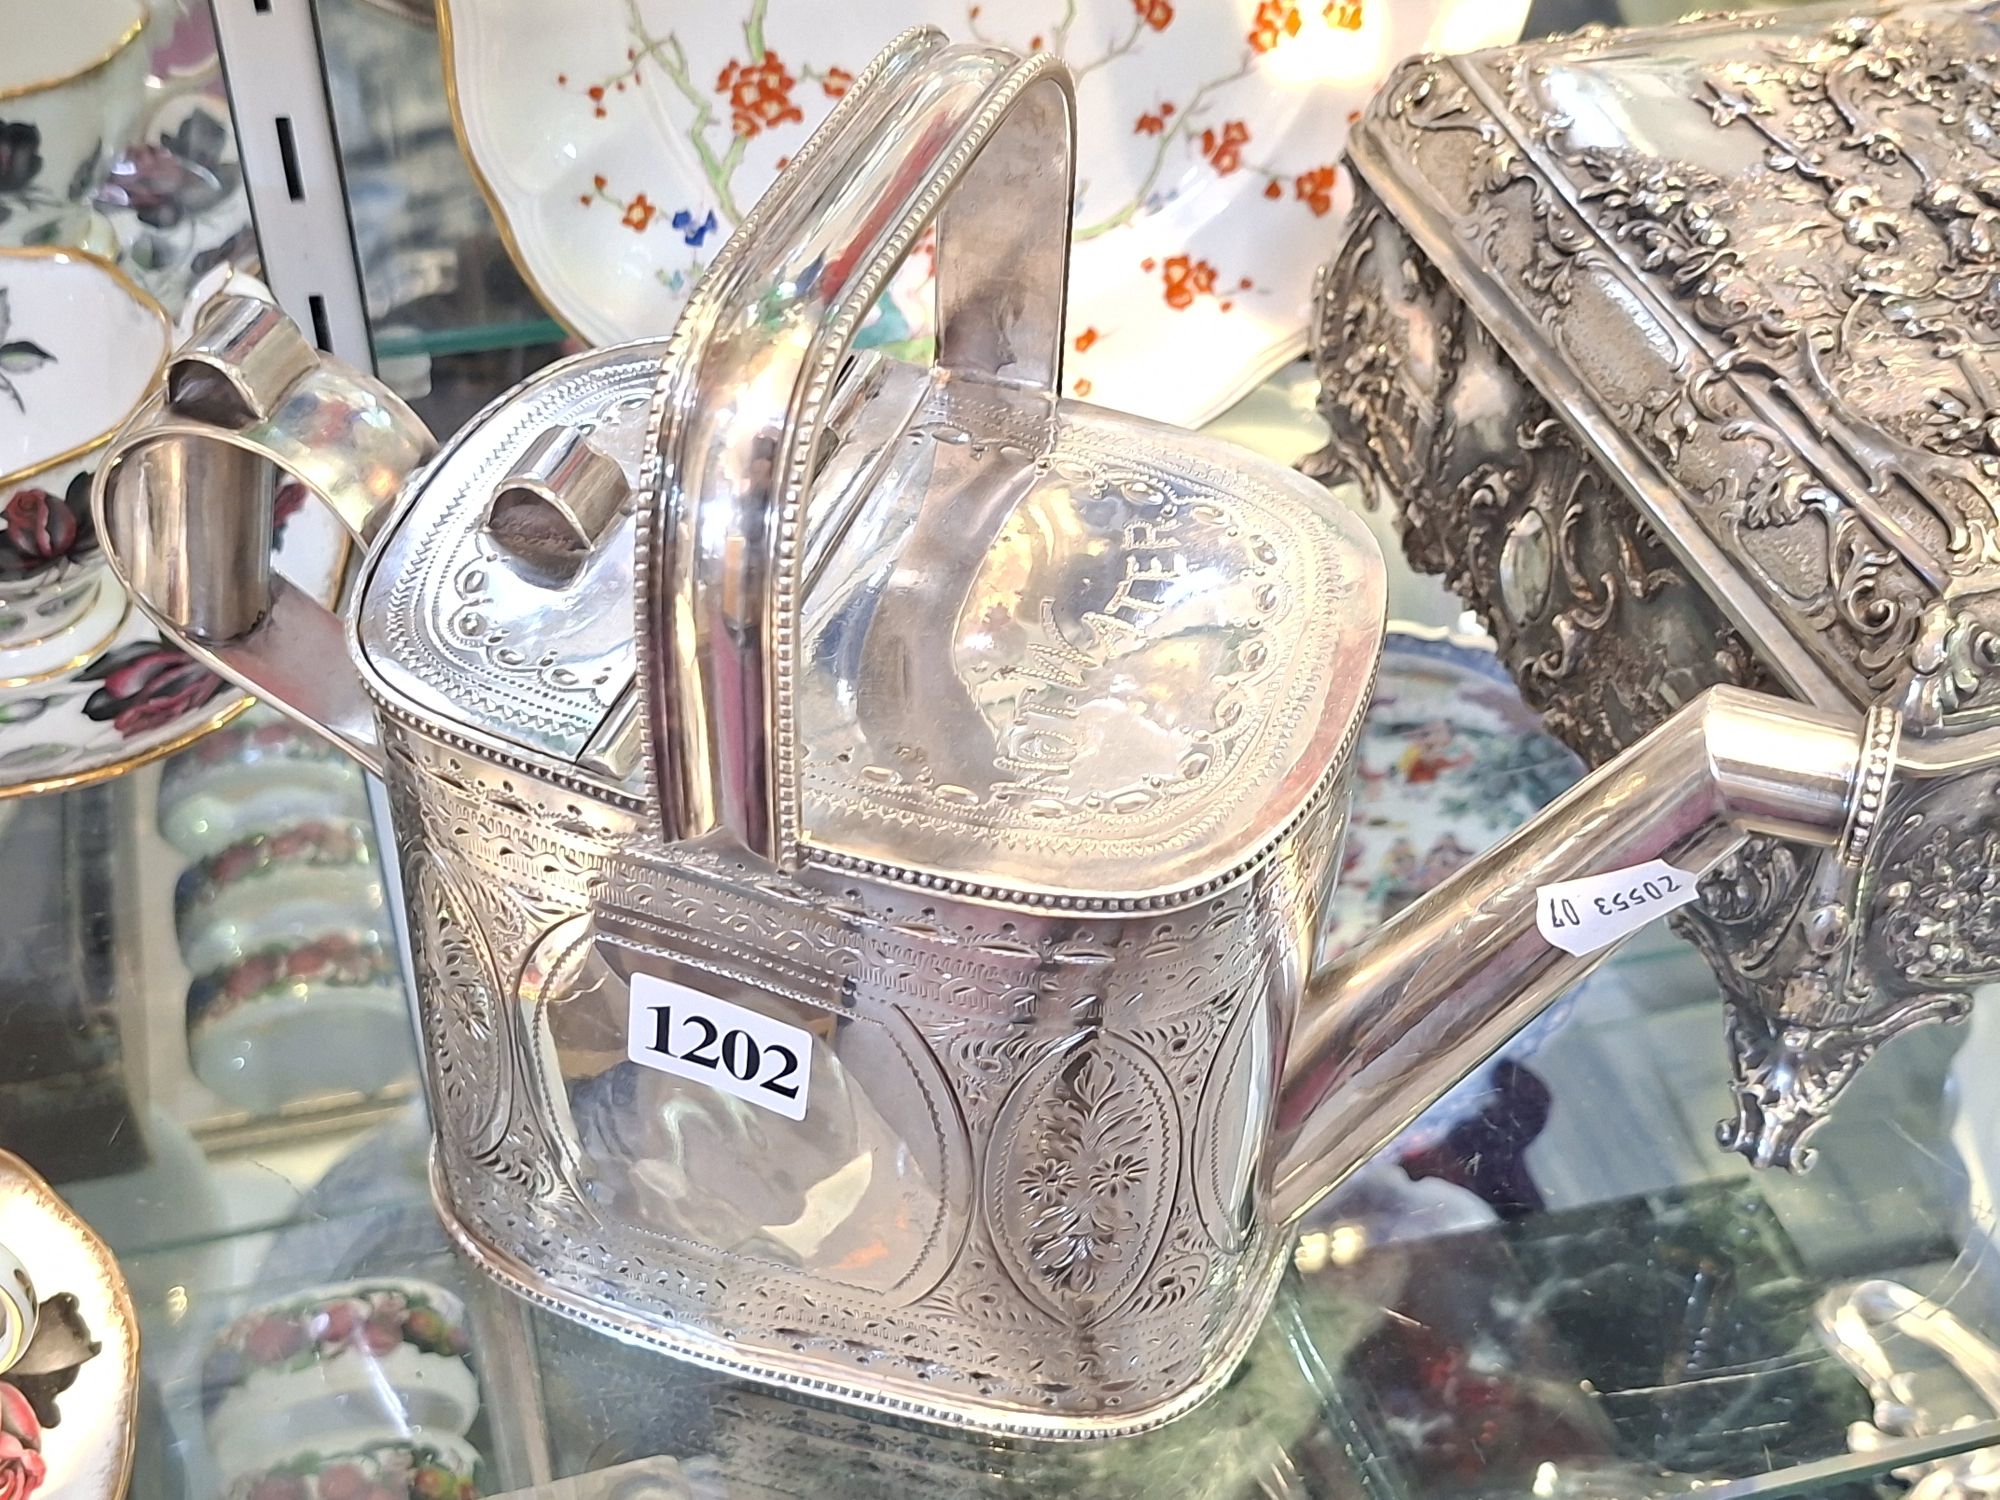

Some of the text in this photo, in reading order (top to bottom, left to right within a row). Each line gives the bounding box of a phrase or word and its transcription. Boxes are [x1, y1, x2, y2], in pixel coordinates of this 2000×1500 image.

[994, 518, 1188, 692] WATER
[1550, 875, 1682, 927] 20553 07
[645, 1005, 799, 1099] 1202
